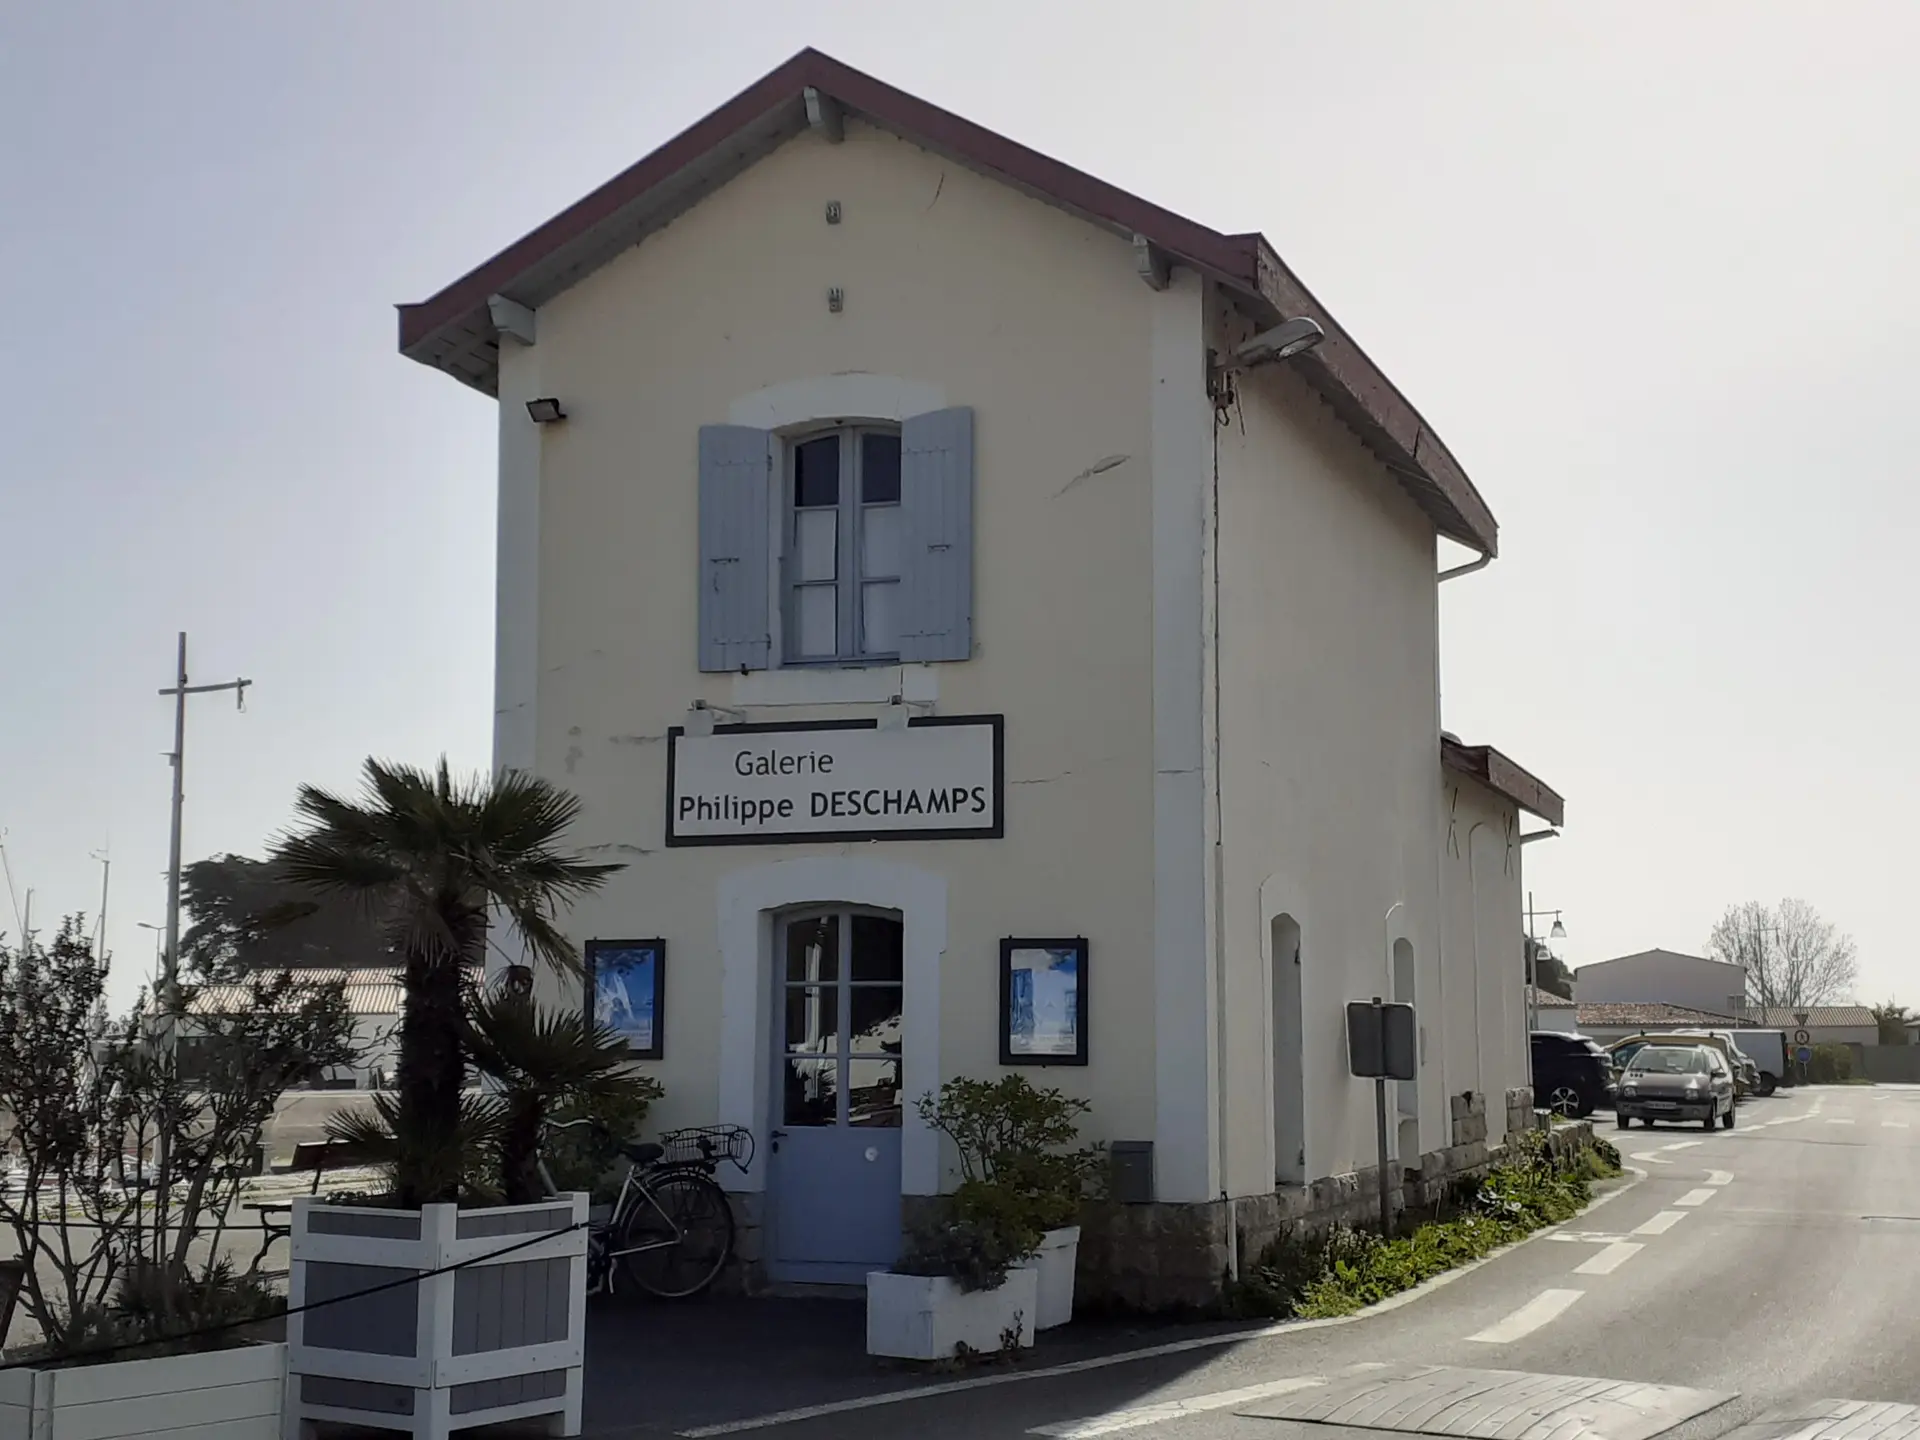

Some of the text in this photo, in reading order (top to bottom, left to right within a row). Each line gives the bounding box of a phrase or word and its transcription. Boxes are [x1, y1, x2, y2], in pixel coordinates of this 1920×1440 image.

[735, 750, 834, 776] Galerie
[679, 787, 986, 825] Philippe DESCHAMPS
